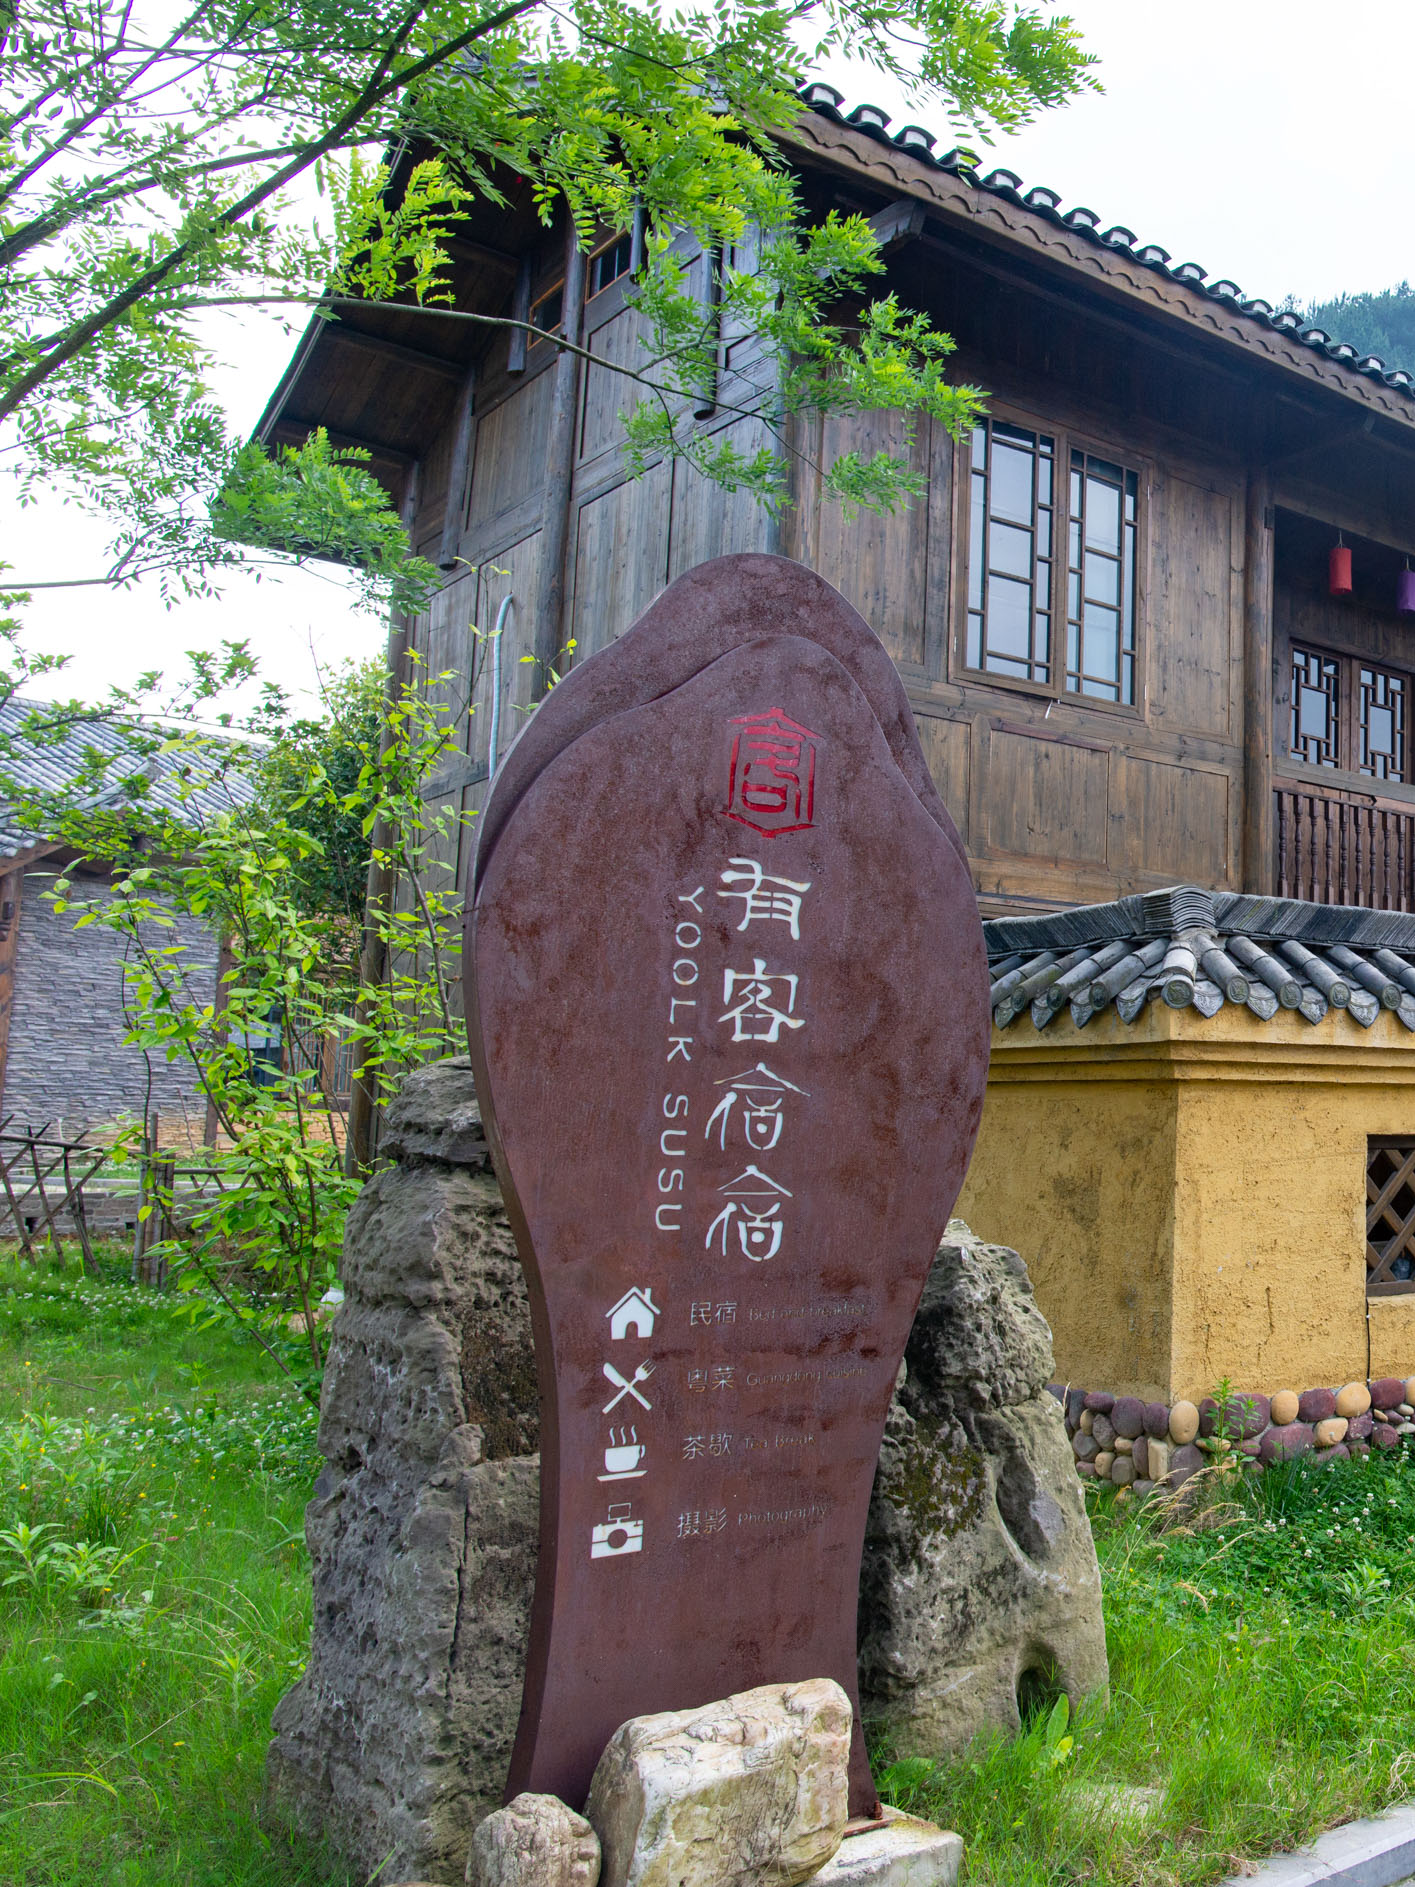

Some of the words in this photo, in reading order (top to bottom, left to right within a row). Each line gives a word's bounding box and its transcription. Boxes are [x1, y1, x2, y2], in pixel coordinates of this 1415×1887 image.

[666, 886, 704, 1063] YOOLK
[654, 1094, 690, 1232] SUSU
[689, 1301, 738, 1326] 民宿
[687, 1366, 736, 1393] 粤菜
[746, 1370, 822, 1387] Guangdong
[682, 1432, 734, 1460] 茶歇
[744, 1437, 769, 1449] Tea
[677, 1506, 728, 1538] 摄影
[738, 1503, 829, 1526] Photography
